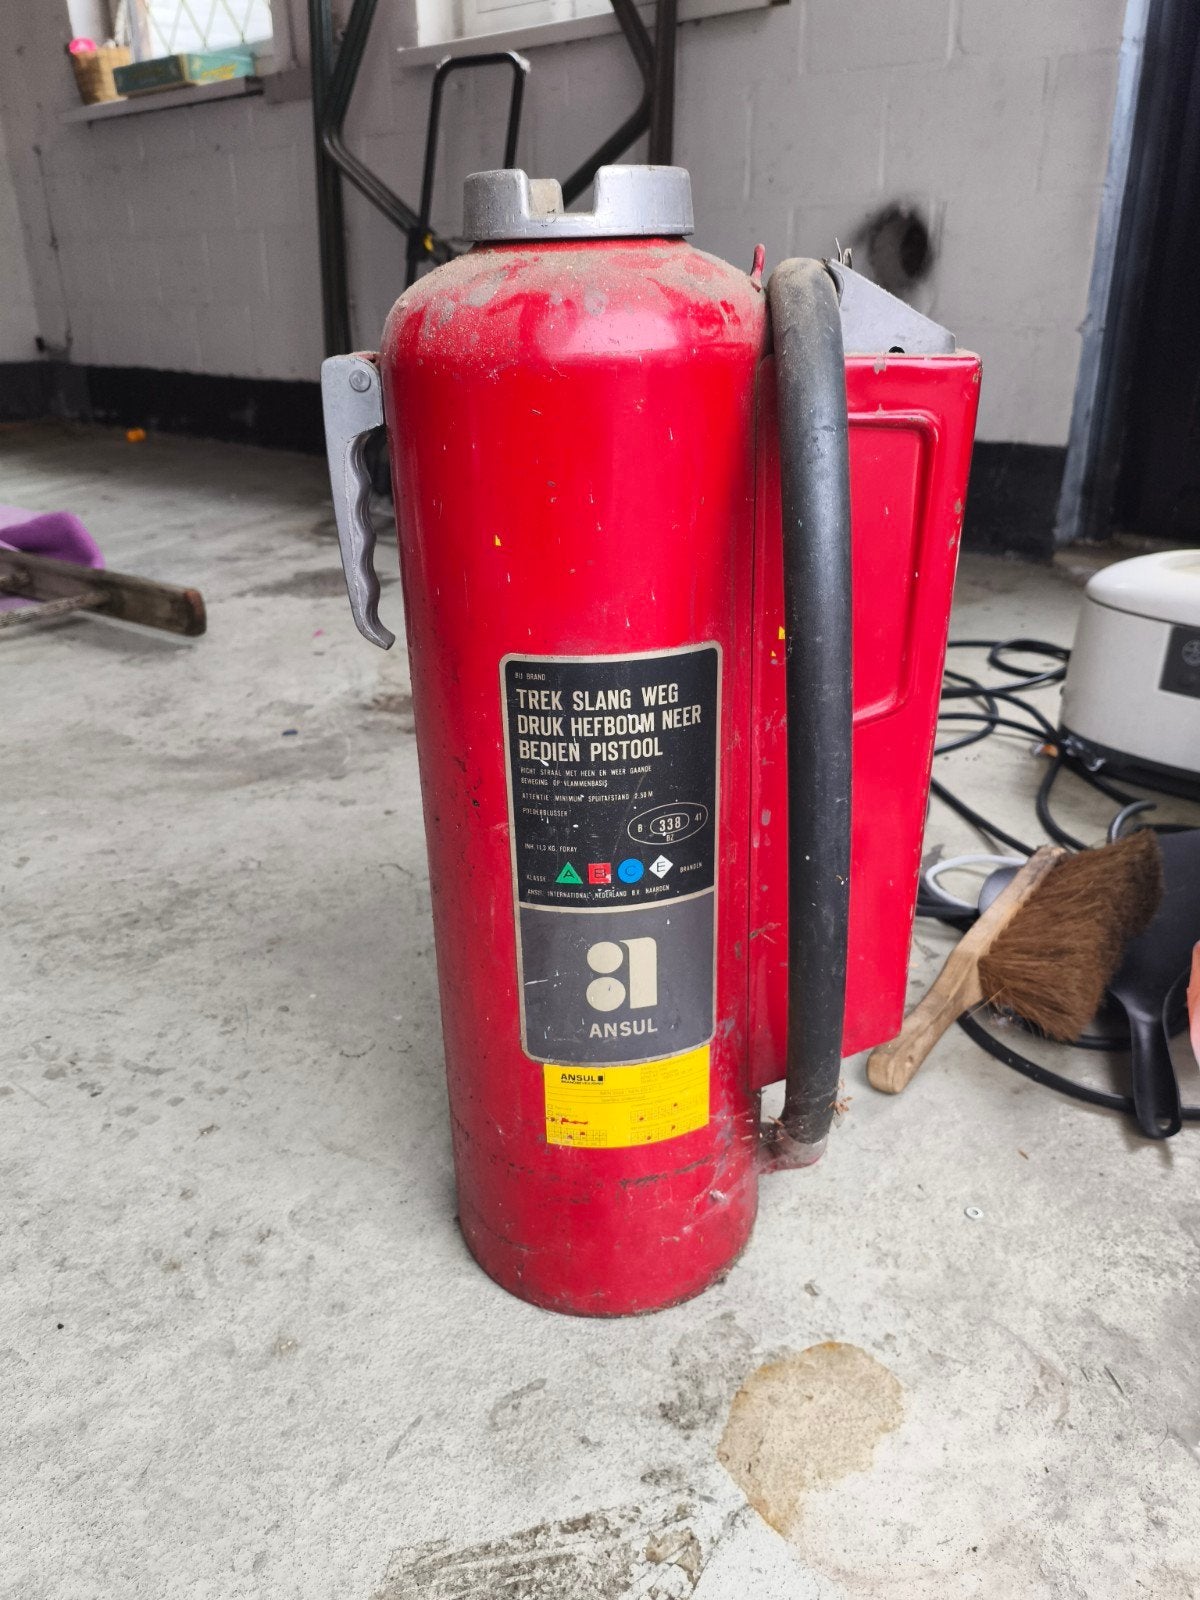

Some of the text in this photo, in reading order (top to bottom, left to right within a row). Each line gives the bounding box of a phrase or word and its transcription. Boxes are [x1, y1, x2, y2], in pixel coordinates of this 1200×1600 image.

[526, 673, 546, 681] BRAND
[516, 683, 679, 711] TREK SLANG WEG
[517, 704, 702, 737] DRUK HEFBOOM NEER
[519, 737, 664, 762] BEDIEN PISTOOL
[599, 769, 607, 777] EN
[610, 768, 626, 776] WEER
[522, 792, 549, 801] ATTENTIE
[659, 816, 681, 832] 338
[563, 869, 575, 878] A
[656, 861, 666, 873] E
[589, 1018, 658, 1038] ANSUL
[560, 1073, 596, 1082] ANSUL
